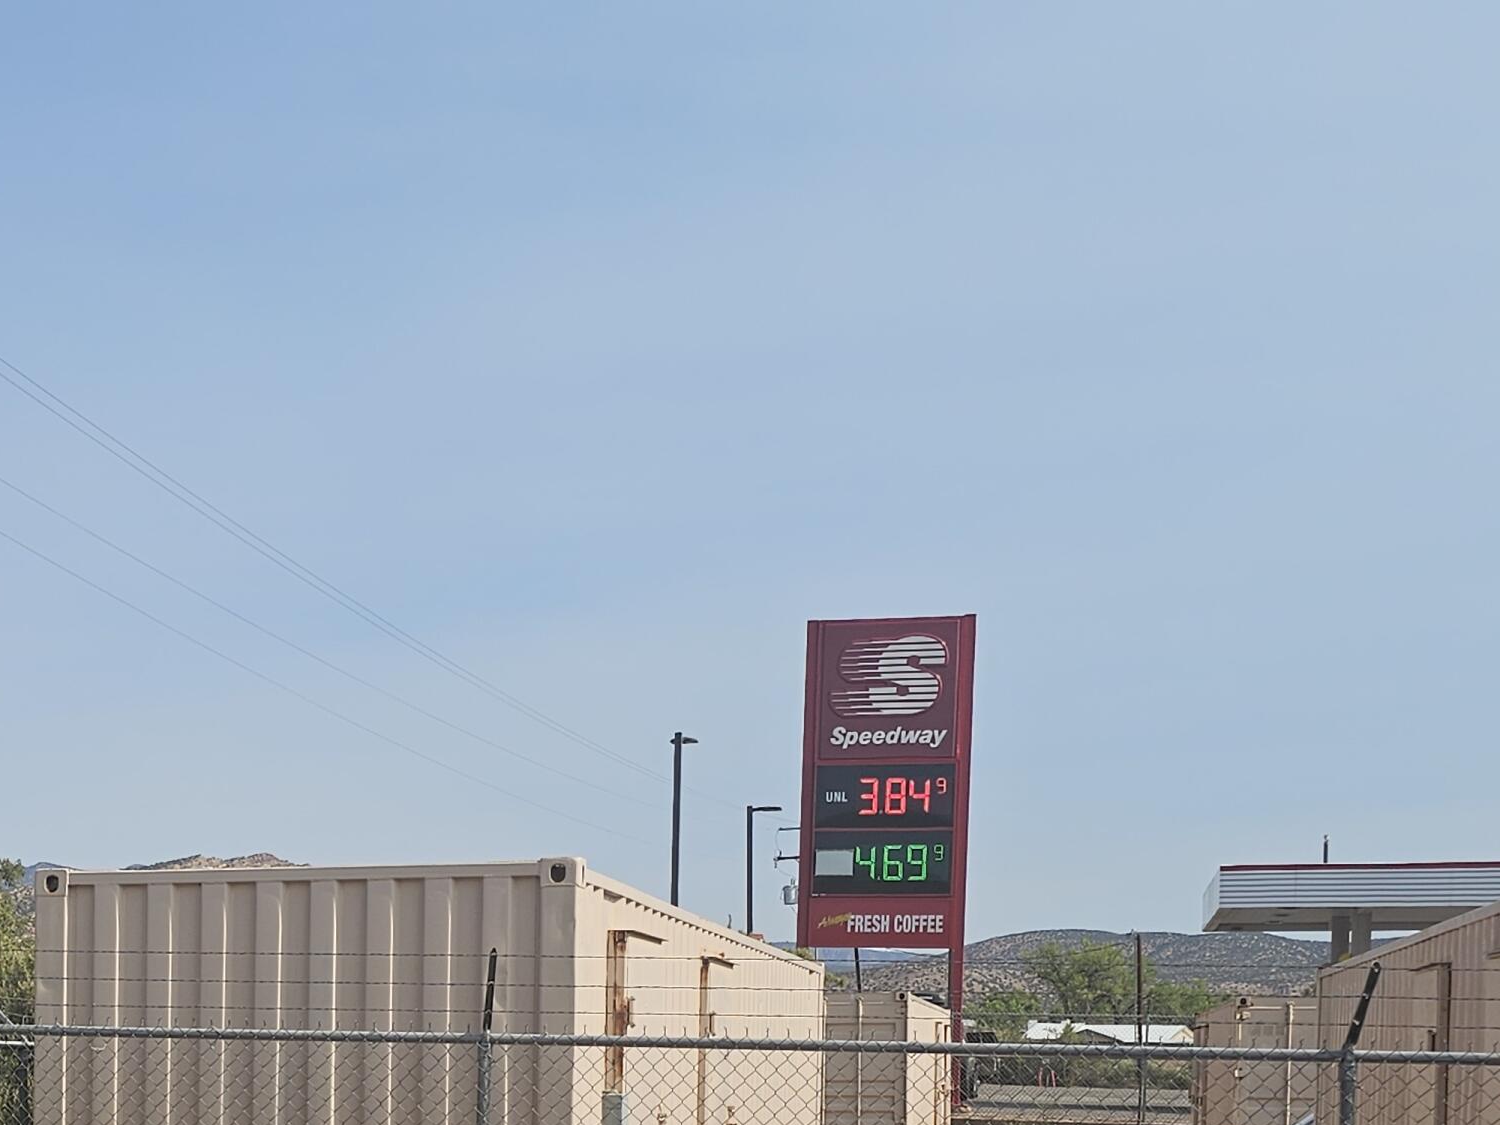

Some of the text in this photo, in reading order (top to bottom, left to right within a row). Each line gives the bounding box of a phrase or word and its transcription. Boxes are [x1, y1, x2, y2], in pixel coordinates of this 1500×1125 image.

[830, 726, 948, 749] Speedway
[826, 791, 849, 803] UNL
[846, 914, 890, 933] FRESH
[894, 914, 944, 933] COFFEE
